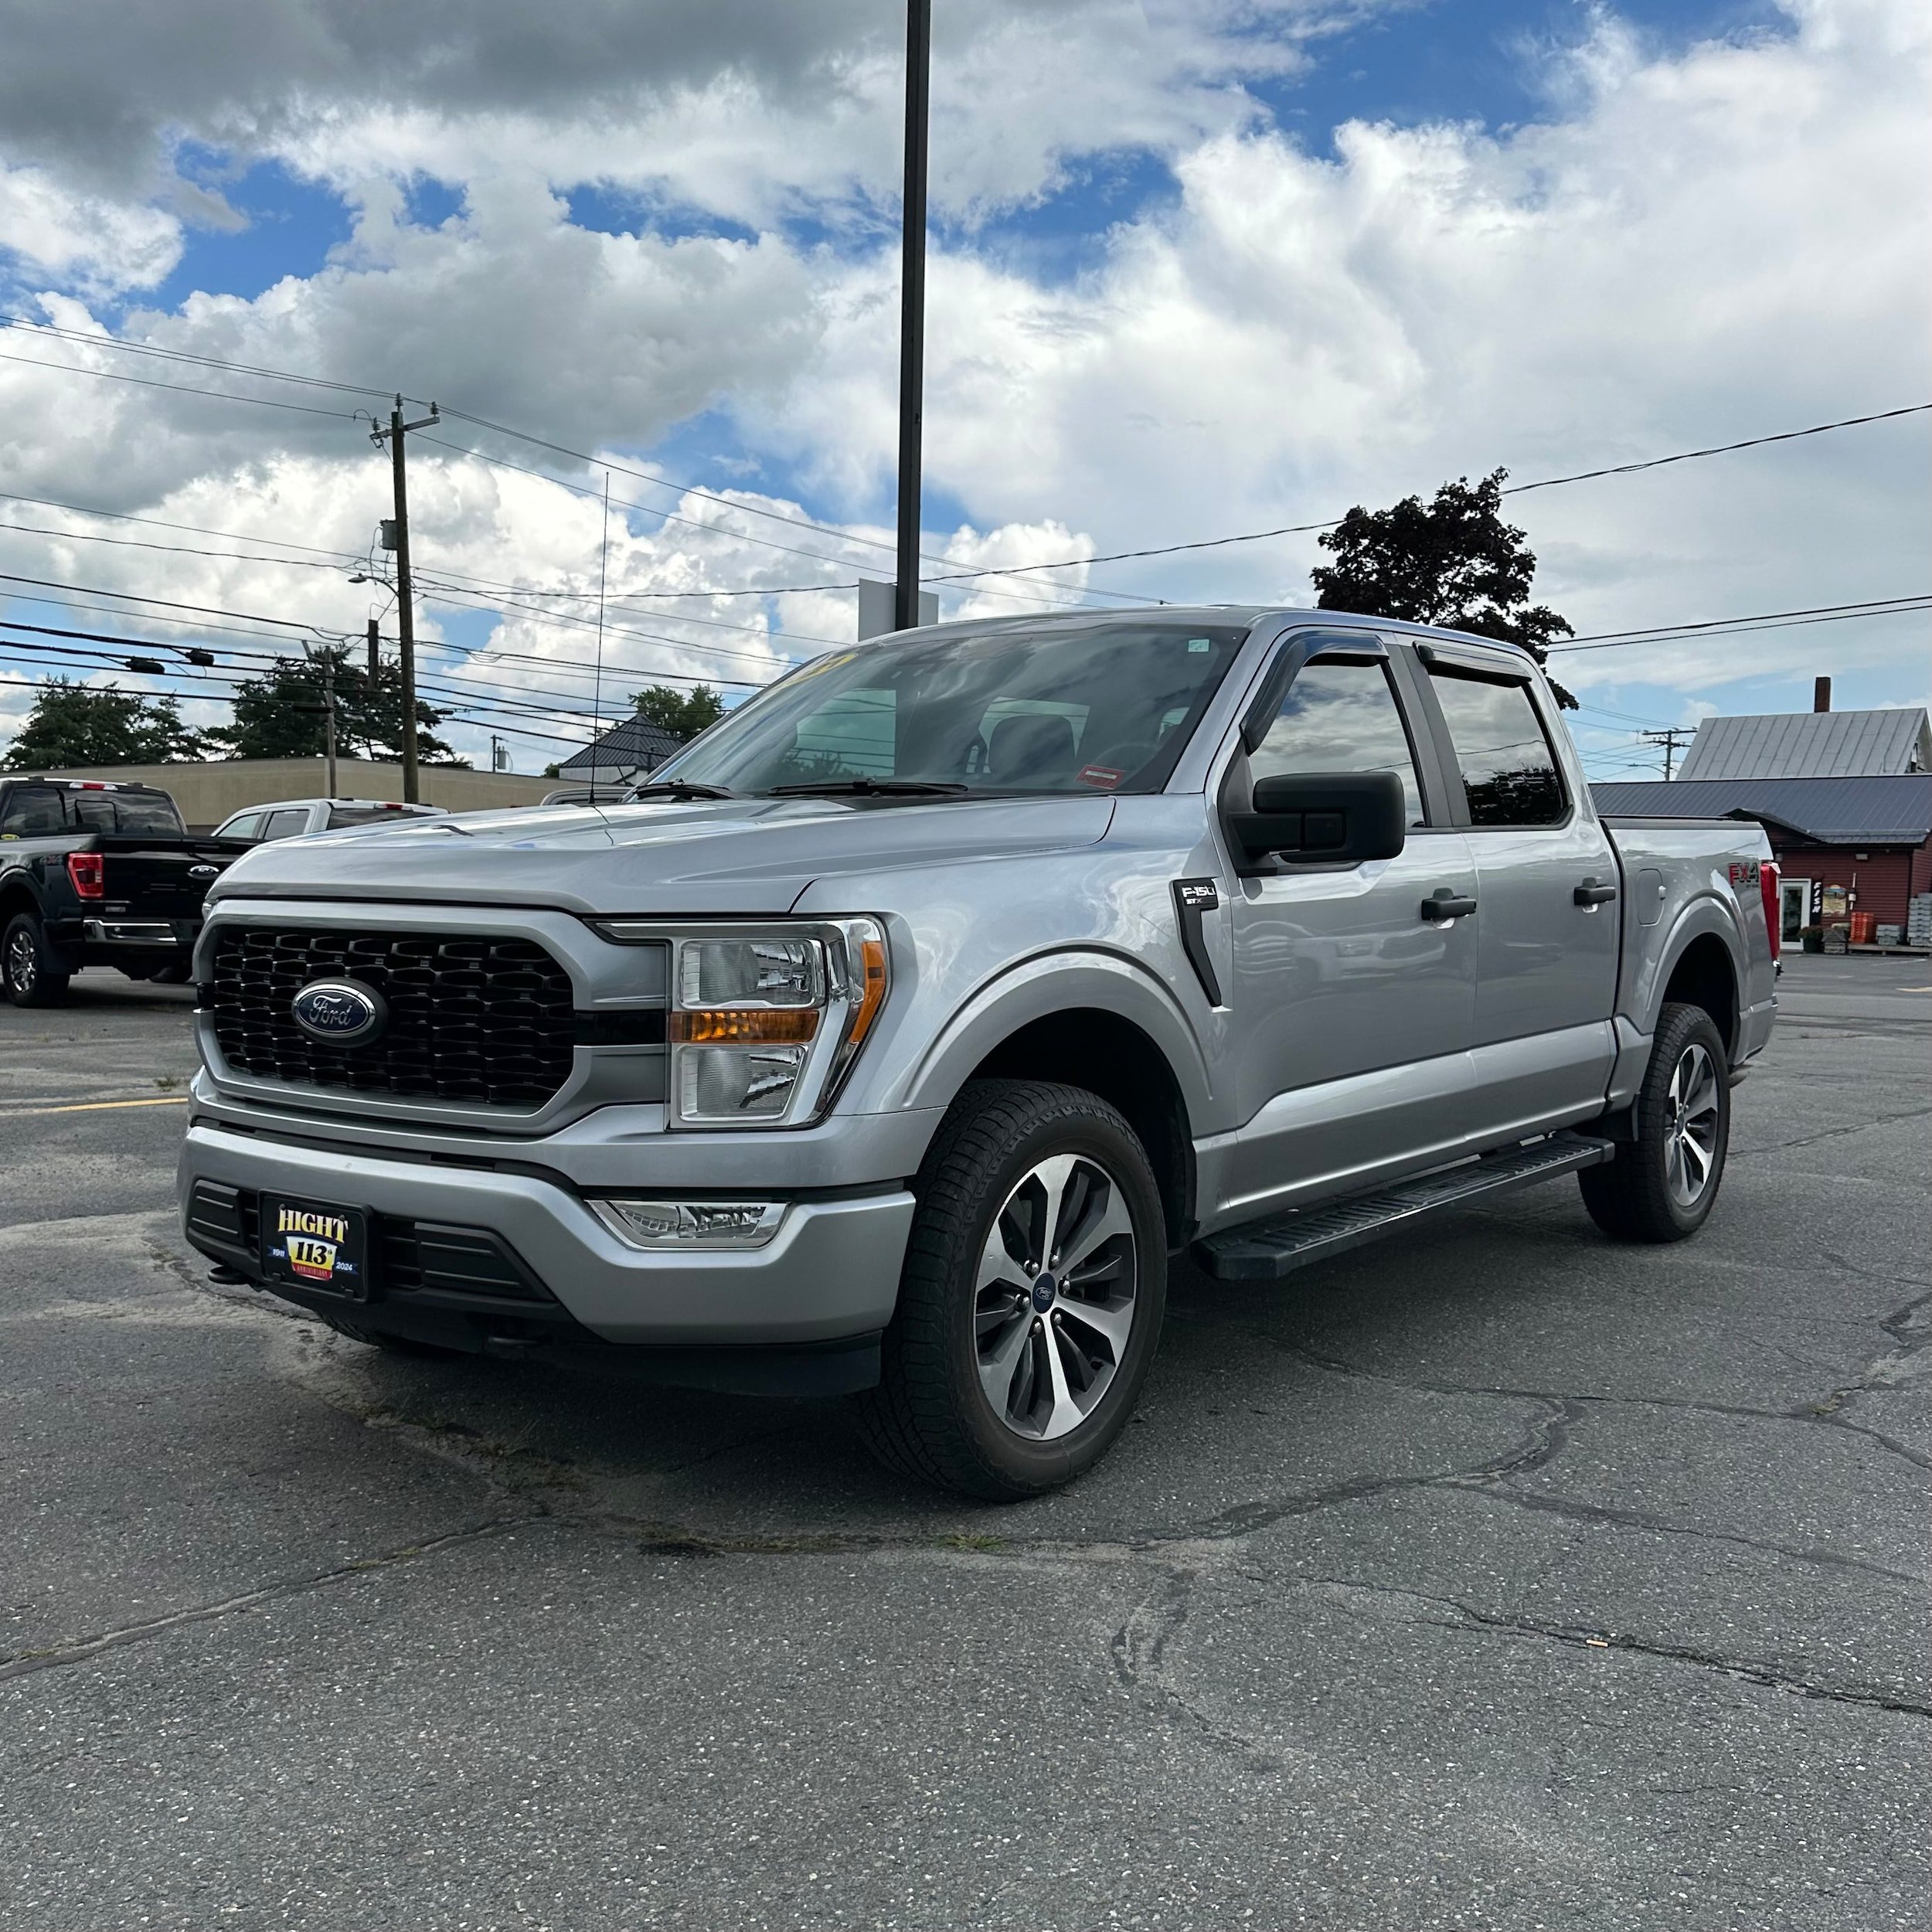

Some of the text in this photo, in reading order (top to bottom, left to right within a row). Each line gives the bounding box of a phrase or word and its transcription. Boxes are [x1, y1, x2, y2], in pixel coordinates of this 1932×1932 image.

[1728, 862, 1759, 888] FX4
[1182, 886, 1216, 897] F-150
[1812, 882, 1821, 913] FISH
[309, 995, 352, 1026] Ford
[277, 1209, 349, 1244] HIGHT
[272, 1248, 285, 1257] 1911
[335, 1261, 353, 1271] 2024
